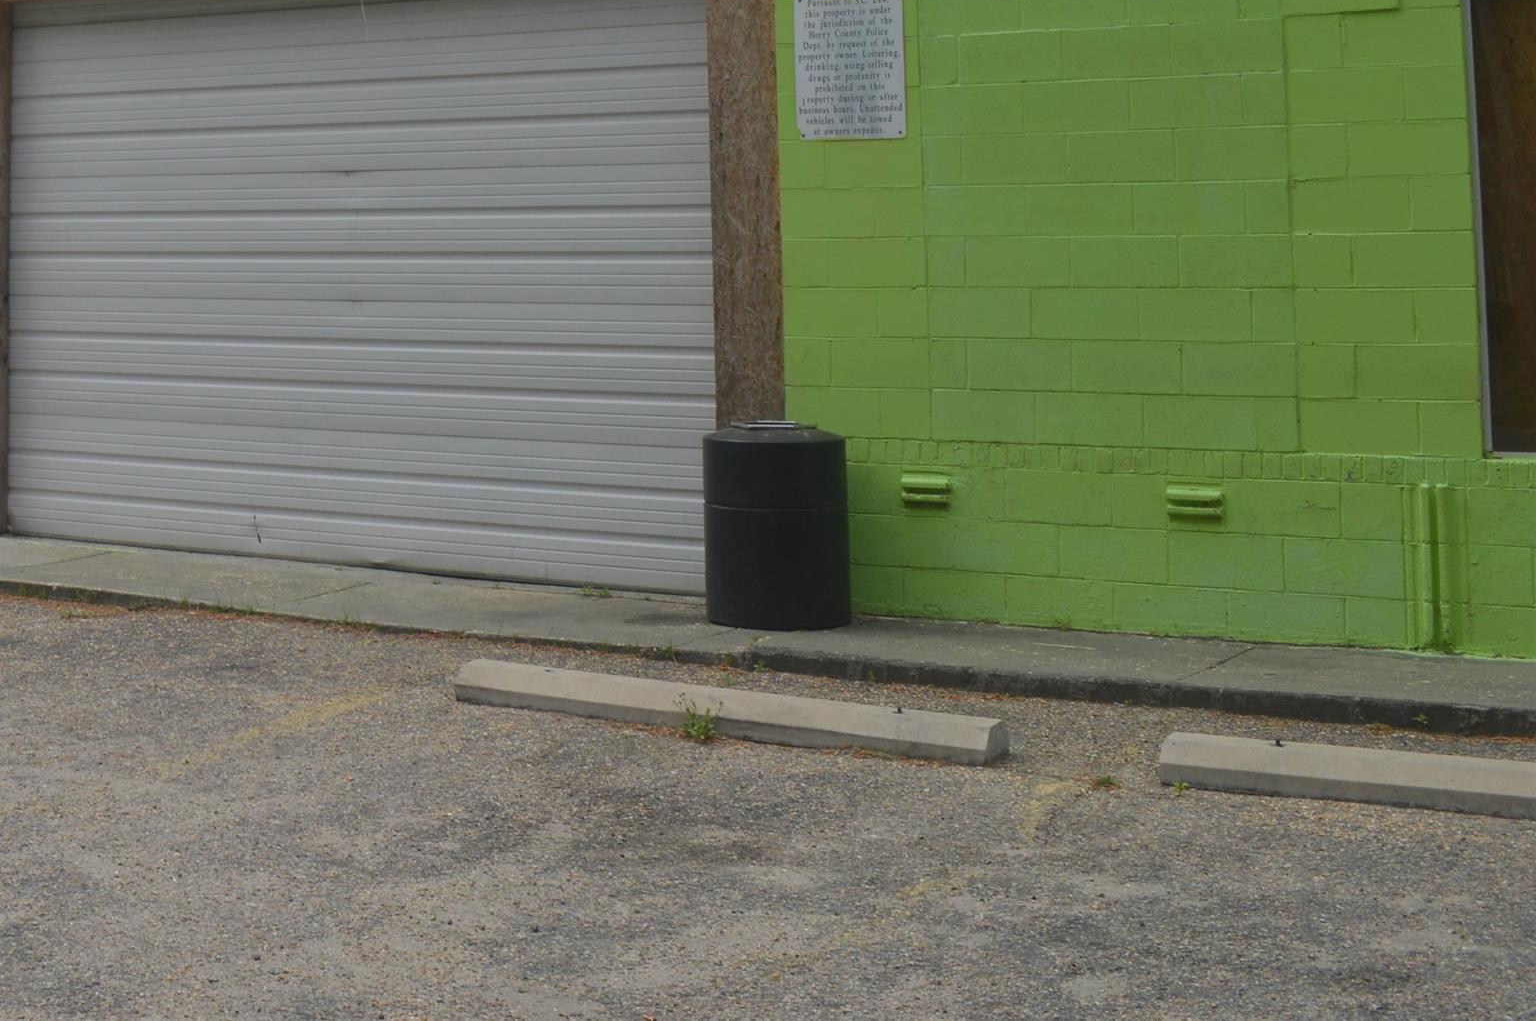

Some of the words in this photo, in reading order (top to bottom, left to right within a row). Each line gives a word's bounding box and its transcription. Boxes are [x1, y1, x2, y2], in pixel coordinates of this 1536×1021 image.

[805, 10, 820, 19] this
[823, 8, 855, 20] property
[869, 5, 891, 15] under
[804, 20, 816, 29] the
[819, 18, 864, 30] jurisdiction
[867, 17, 876, 26] of
[880, 16, 893, 25] the
[808, 30, 830, 40] Horry
[834, 29, 861, 39] County
[866, 27, 889, 37] Police
[826, 40, 835, 51] by
[839, 40, 867, 50] request
[882, 38, 895, 47] the
[798, 53, 830, 63] property
[845, 72, 880, 82] profanity
[814, 84, 854, 94] prohibited
[870, 82, 885, 91] this
[802, 95, 834, 106] property
[838, 94, 864, 103] during
[879, 92, 898, 101] after
[799, 106, 830, 115] business
[859, 102, 903, 113] Unattended
[806, 116, 835, 125] vehicles
[838, 115, 854, 124] will
[857, 115, 867, 124] be
[870, 114, 893, 123] towed
